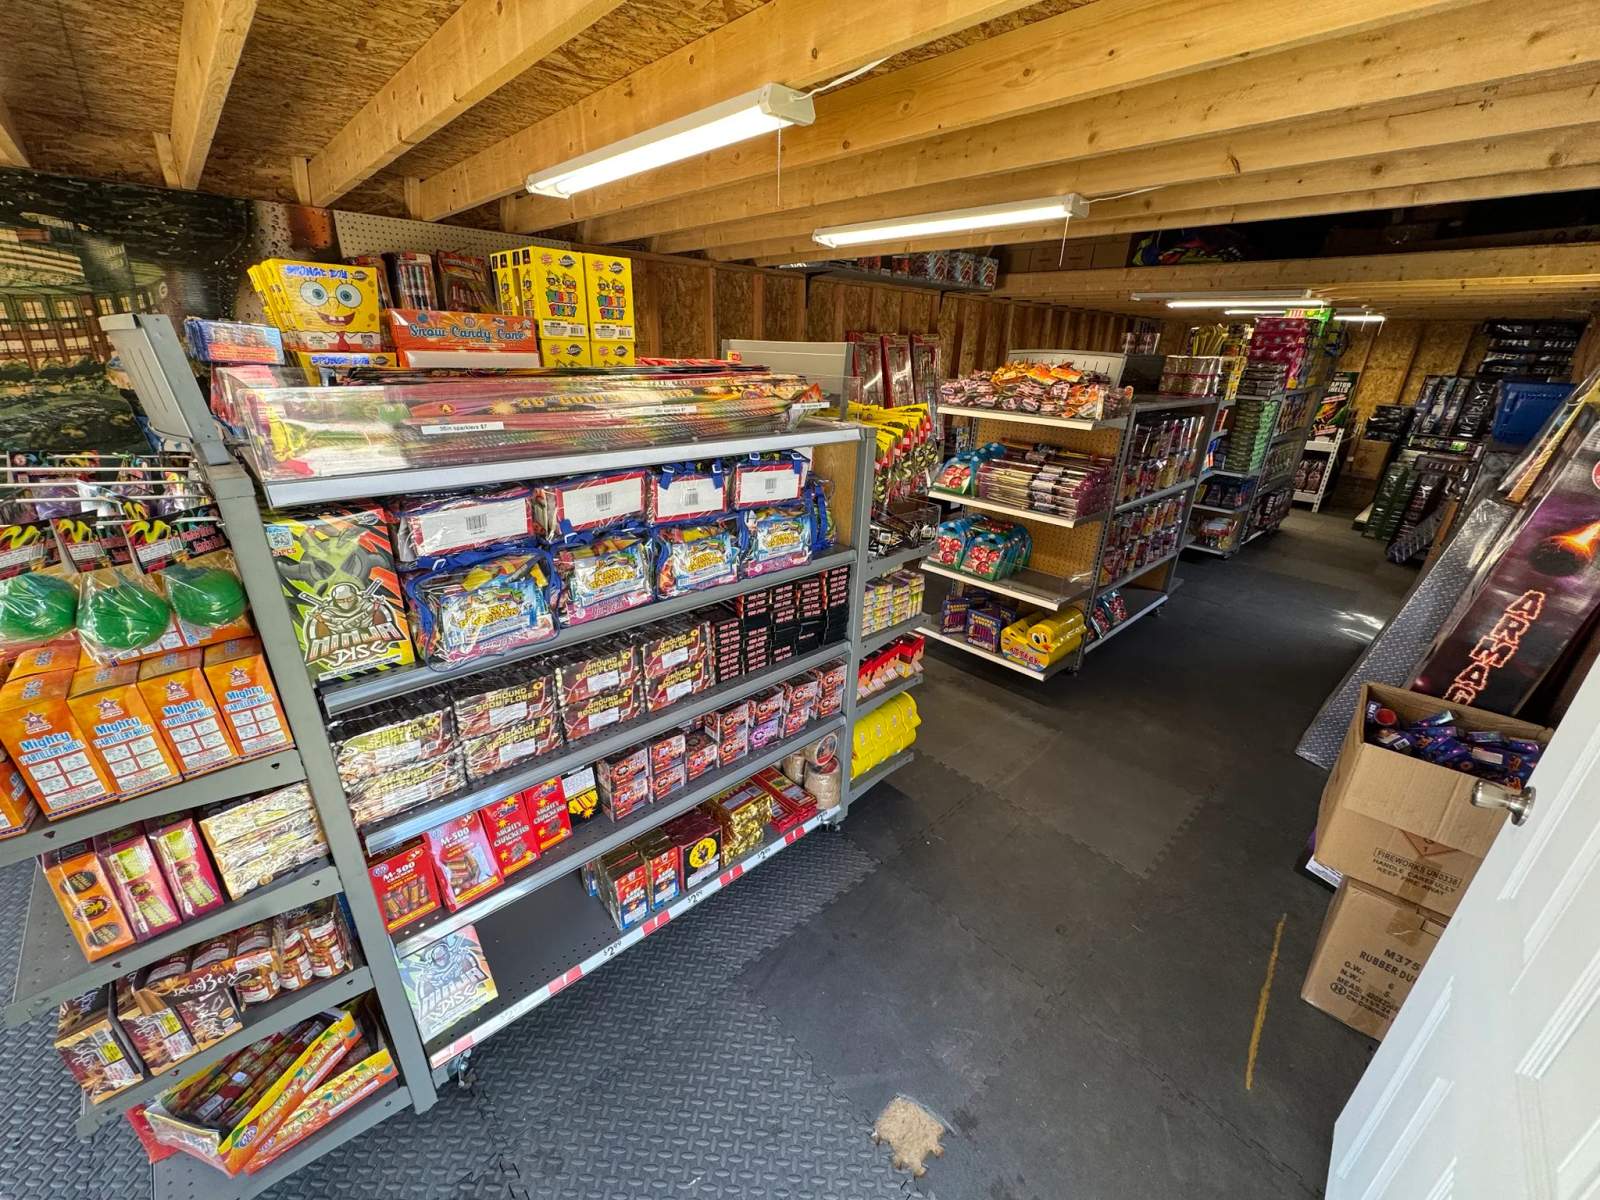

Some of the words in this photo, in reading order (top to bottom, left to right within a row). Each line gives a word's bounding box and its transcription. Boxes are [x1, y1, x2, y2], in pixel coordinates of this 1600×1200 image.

[410, 324, 446, 337] Snow
[451, 326, 491, 342] Candy
[308, 622, 402, 662] NINJA
[333, 640, 387, 666] DISC
[586, 656, 617, 670] GROUND
[598, 660, 628, 672] FLOWER
[227, 687, 263, 700] Mighty
[504, 690, 538, 704] FLOWER
[164, 701, 203, 714] Mighty
[589, 695, 618, 708] GROUND
[601, 697, 628, 711] FLOWER
[95, 718, 140, 734] Mighty
[21, 732, 71, 750] Mighty
[496, 822, 521, 837] MIGHTY
[1377, 850, 1425, 872] FIREWORKS
[383, 862, 415, 881] M-500
[1373, 859, 1403, 873] HANDLE
[1408, 872, 1456, 892] CAREFULLY
[1376, 866, 1398, 877] KEEP
[1360, 950, 1398, 975] RUBBER
[1398, 971, 1417, 984] DU
